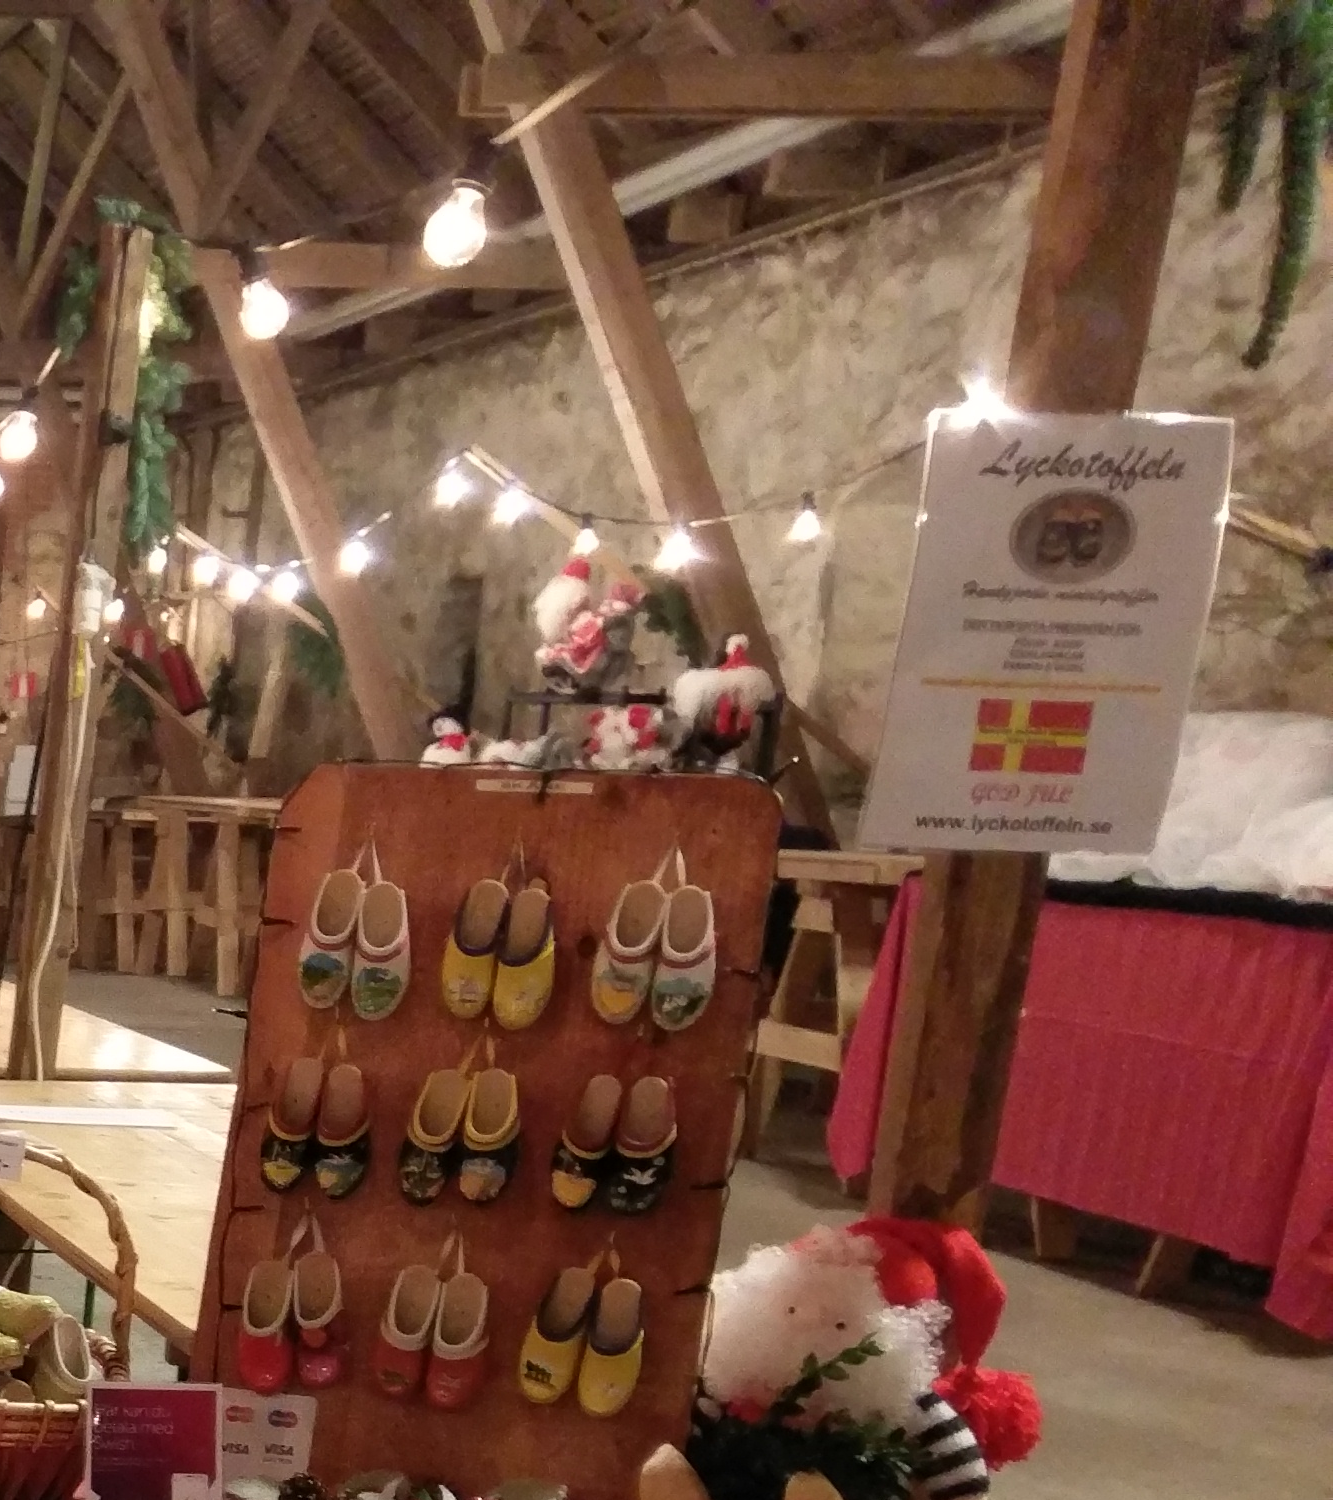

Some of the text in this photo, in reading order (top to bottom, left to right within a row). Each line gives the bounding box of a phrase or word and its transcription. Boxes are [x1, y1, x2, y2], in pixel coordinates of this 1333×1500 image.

[978, 437, 1186, 492] Lyckotoffeln
[915, 814, 1113, 836] www.lyckotoffeln.se
[222, 1442, 295, 1457] VISA VISA
